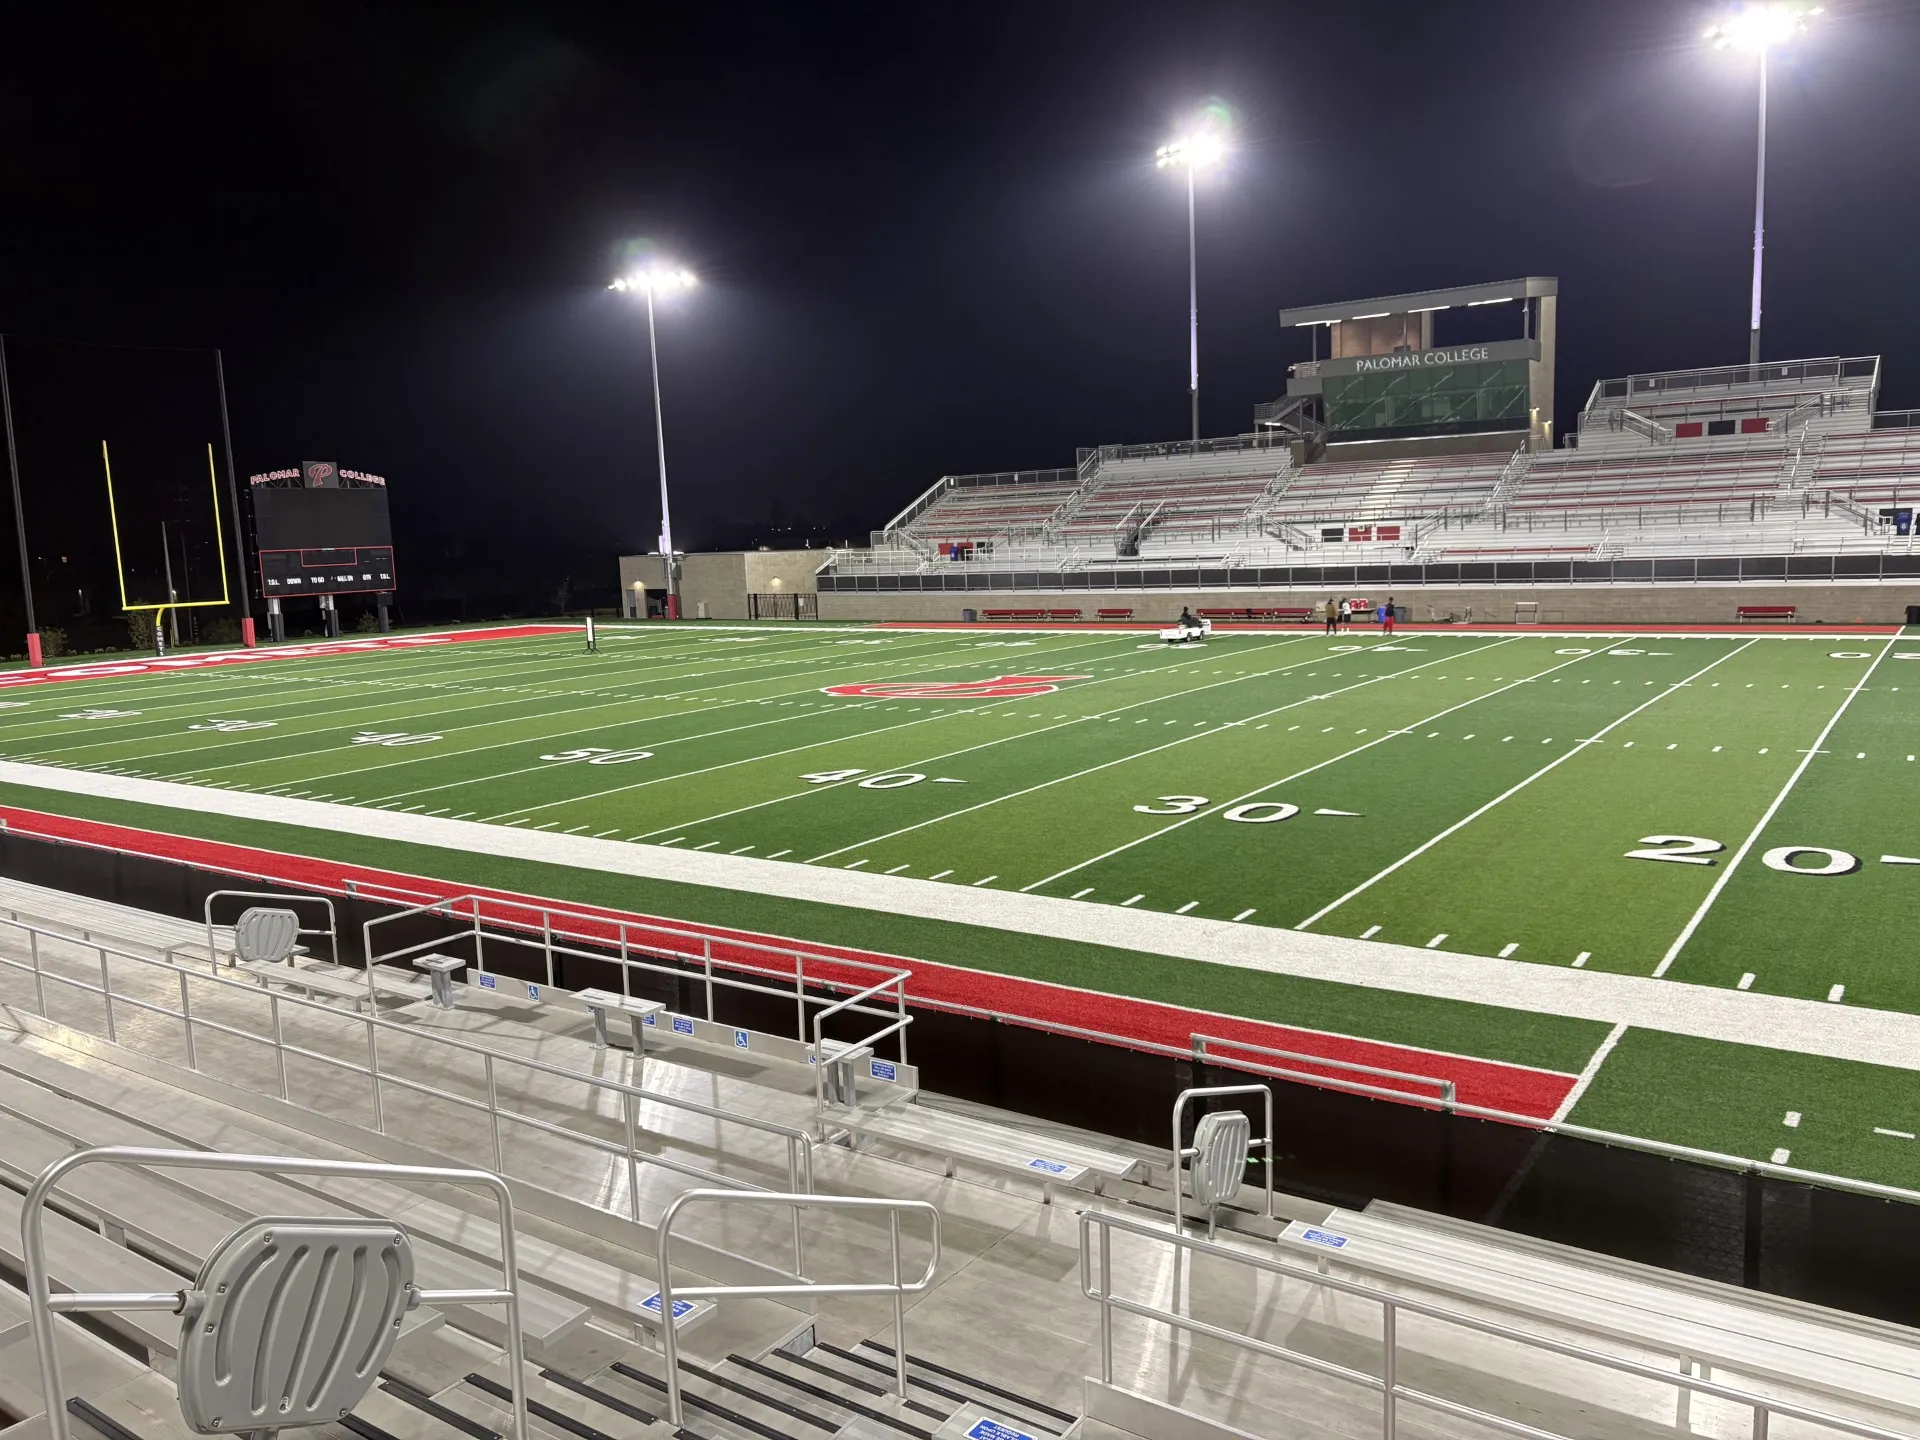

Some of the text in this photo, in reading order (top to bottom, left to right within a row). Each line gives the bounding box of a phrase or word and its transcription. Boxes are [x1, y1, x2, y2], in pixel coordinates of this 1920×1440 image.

[1356, 347, 1489, 372] PALOMAR COLLEGE
[250, 468, 386, 486] PALOMAR COLLEGE
[156, 626, 165, 656] COMETS
[538, 747, 655, 765] 50
[798, 768, 928, 790] 40
[1132, 795, 1302, 824] 30
[1623, 835, 1862, 876] 20
[993, 1425, 1020, 1438] REQUEST
